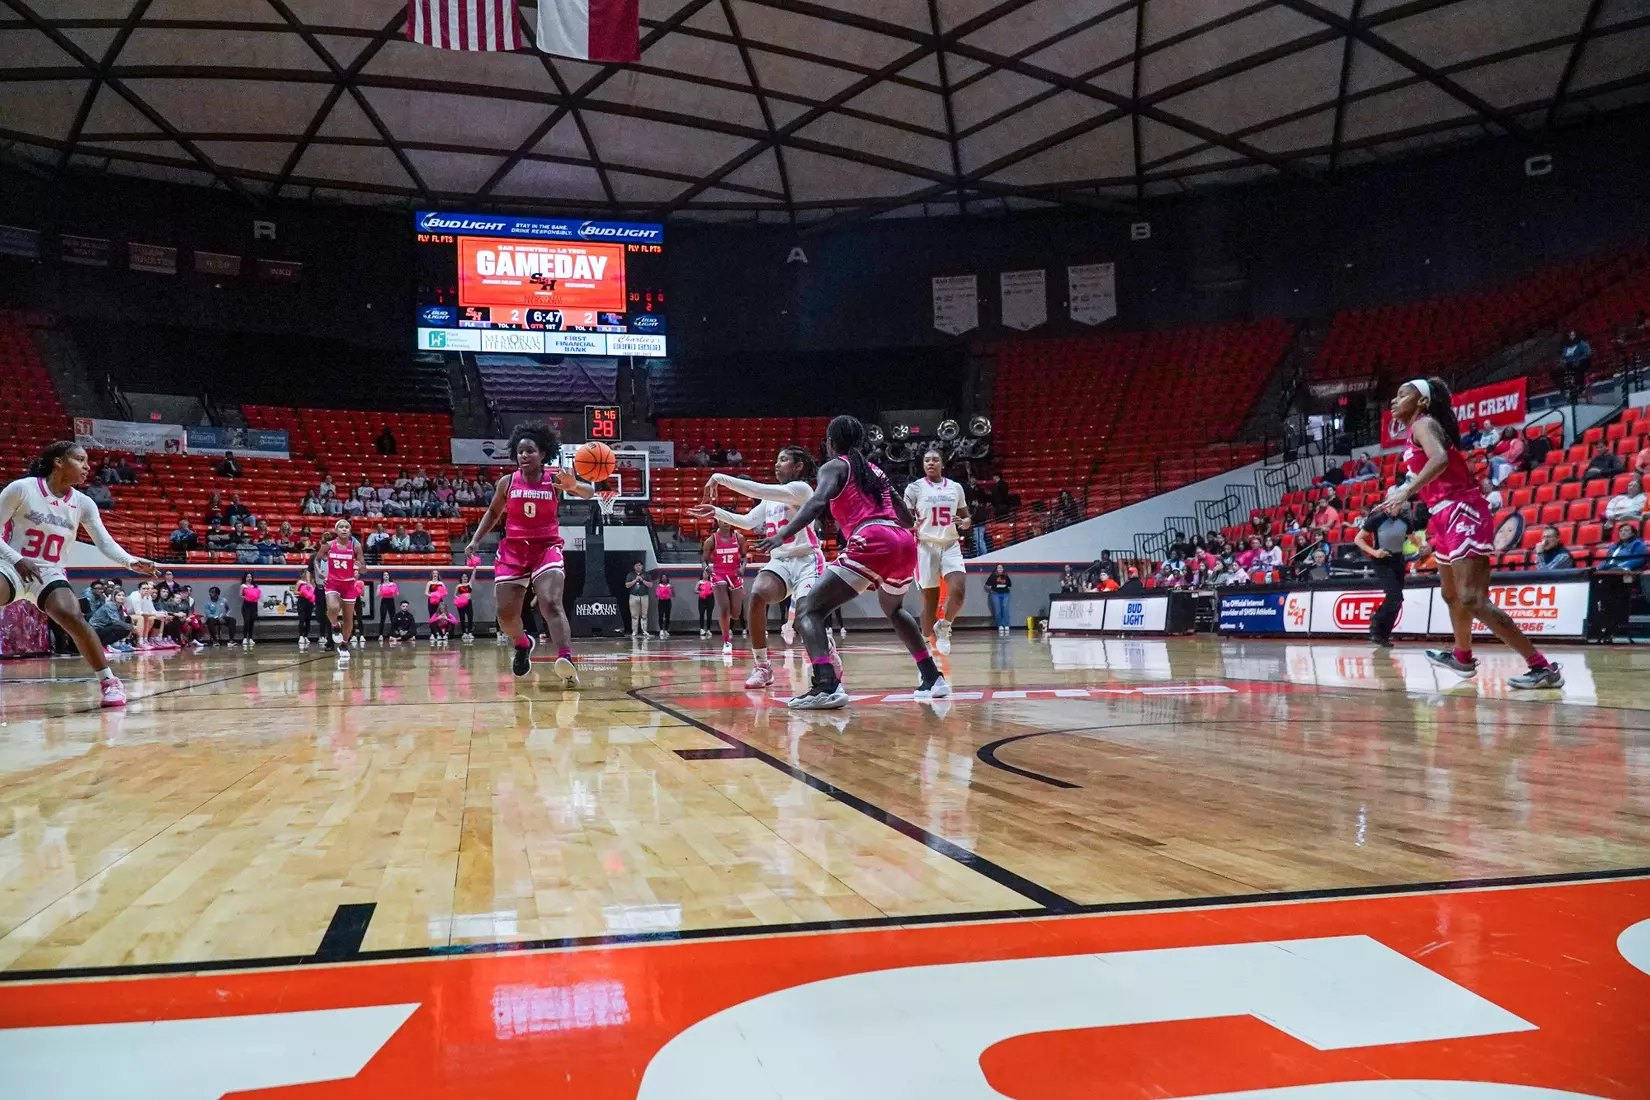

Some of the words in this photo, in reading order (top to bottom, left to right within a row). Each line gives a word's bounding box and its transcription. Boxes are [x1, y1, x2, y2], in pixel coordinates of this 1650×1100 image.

[1524, 154, 1553, 176] C
[254, 220, 276, 239] R
[427, 218, 461, 228] BUD
[462, 220, 506, 231] LIGHT
[584, 226, 616, 236] BUD
[616, 228, 659, 238] LIGHT
[1131, 222, 1151, 241] B
[787, 247, 808, 263] A
[475, 250, 607, 281] GAMEDAY
[511, 310, 519, 321] 2
[533, 311, 561, 323] 6:47
[584, 312, 593, 324] 2
[1479, 392, 1519, 417] CREW
[604, 410, 616, 420] 46
[592, 420, 614, 438] 28
[523, 490, 553, 500] HOUSTON
[524, 502, 536, 518] 0
[932, 507, 951, 526] 15
[21, 528, 64, 563] 30
[333, 559, 348, 570] 24
[576, 602, 617, 610] MEMORIAL
[1127, 603, 1142, 614] BUD
[1123, 614, 1144, 626] LIGHT
